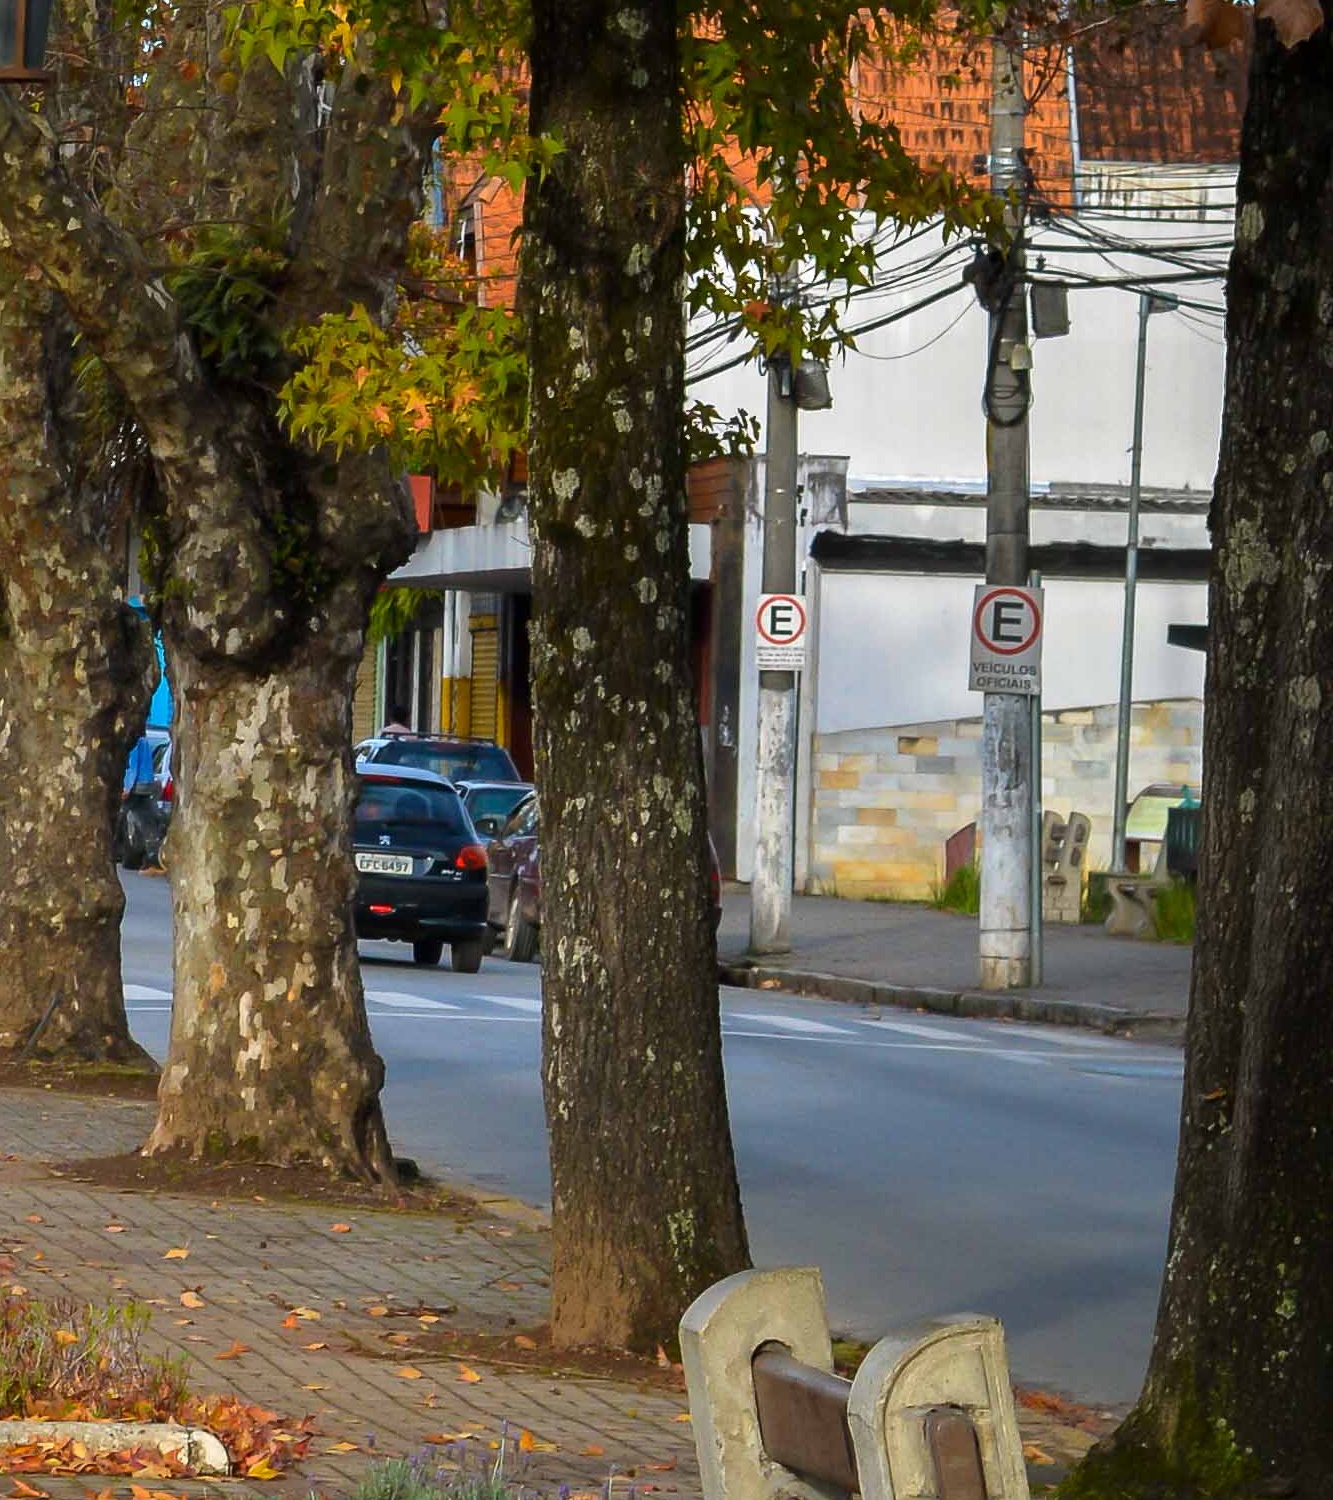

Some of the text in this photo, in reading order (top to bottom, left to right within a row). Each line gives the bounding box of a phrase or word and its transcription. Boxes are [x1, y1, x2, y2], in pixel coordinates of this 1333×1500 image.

[770, 606, 793, 635] E
[992, 601, 1025, 643] E
[976, 677, 1031, 689] OFICIAIS
